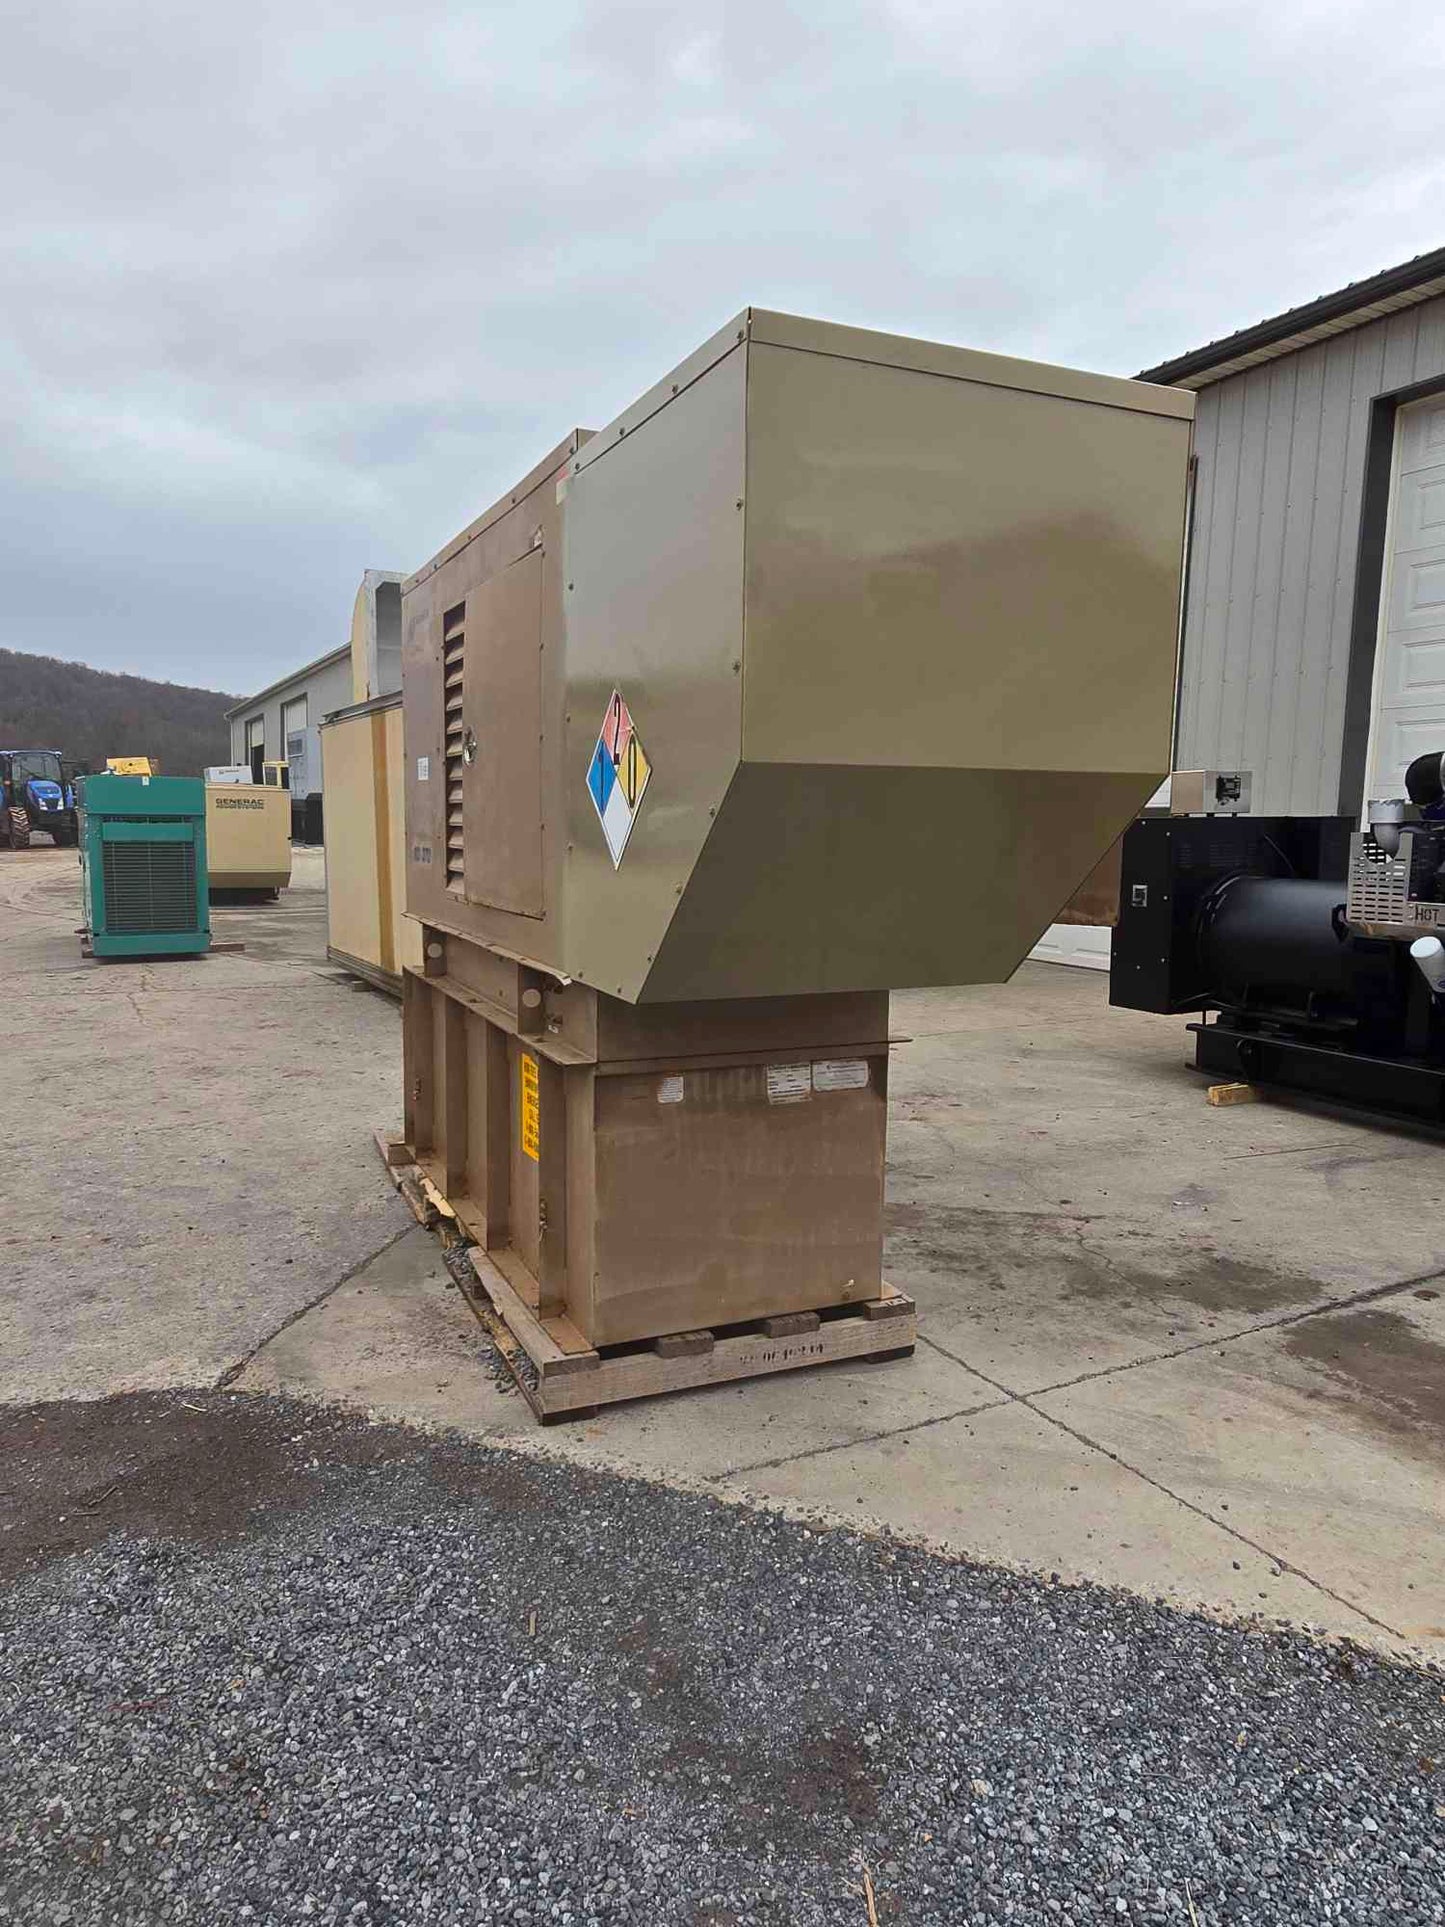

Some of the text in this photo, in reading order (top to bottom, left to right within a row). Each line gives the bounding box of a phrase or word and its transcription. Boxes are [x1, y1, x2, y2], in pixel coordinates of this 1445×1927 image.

[613, 693, 621, 766] 2
[628, 733, 637, 809] 0
[1415, 905, 1440, 922] HOT
